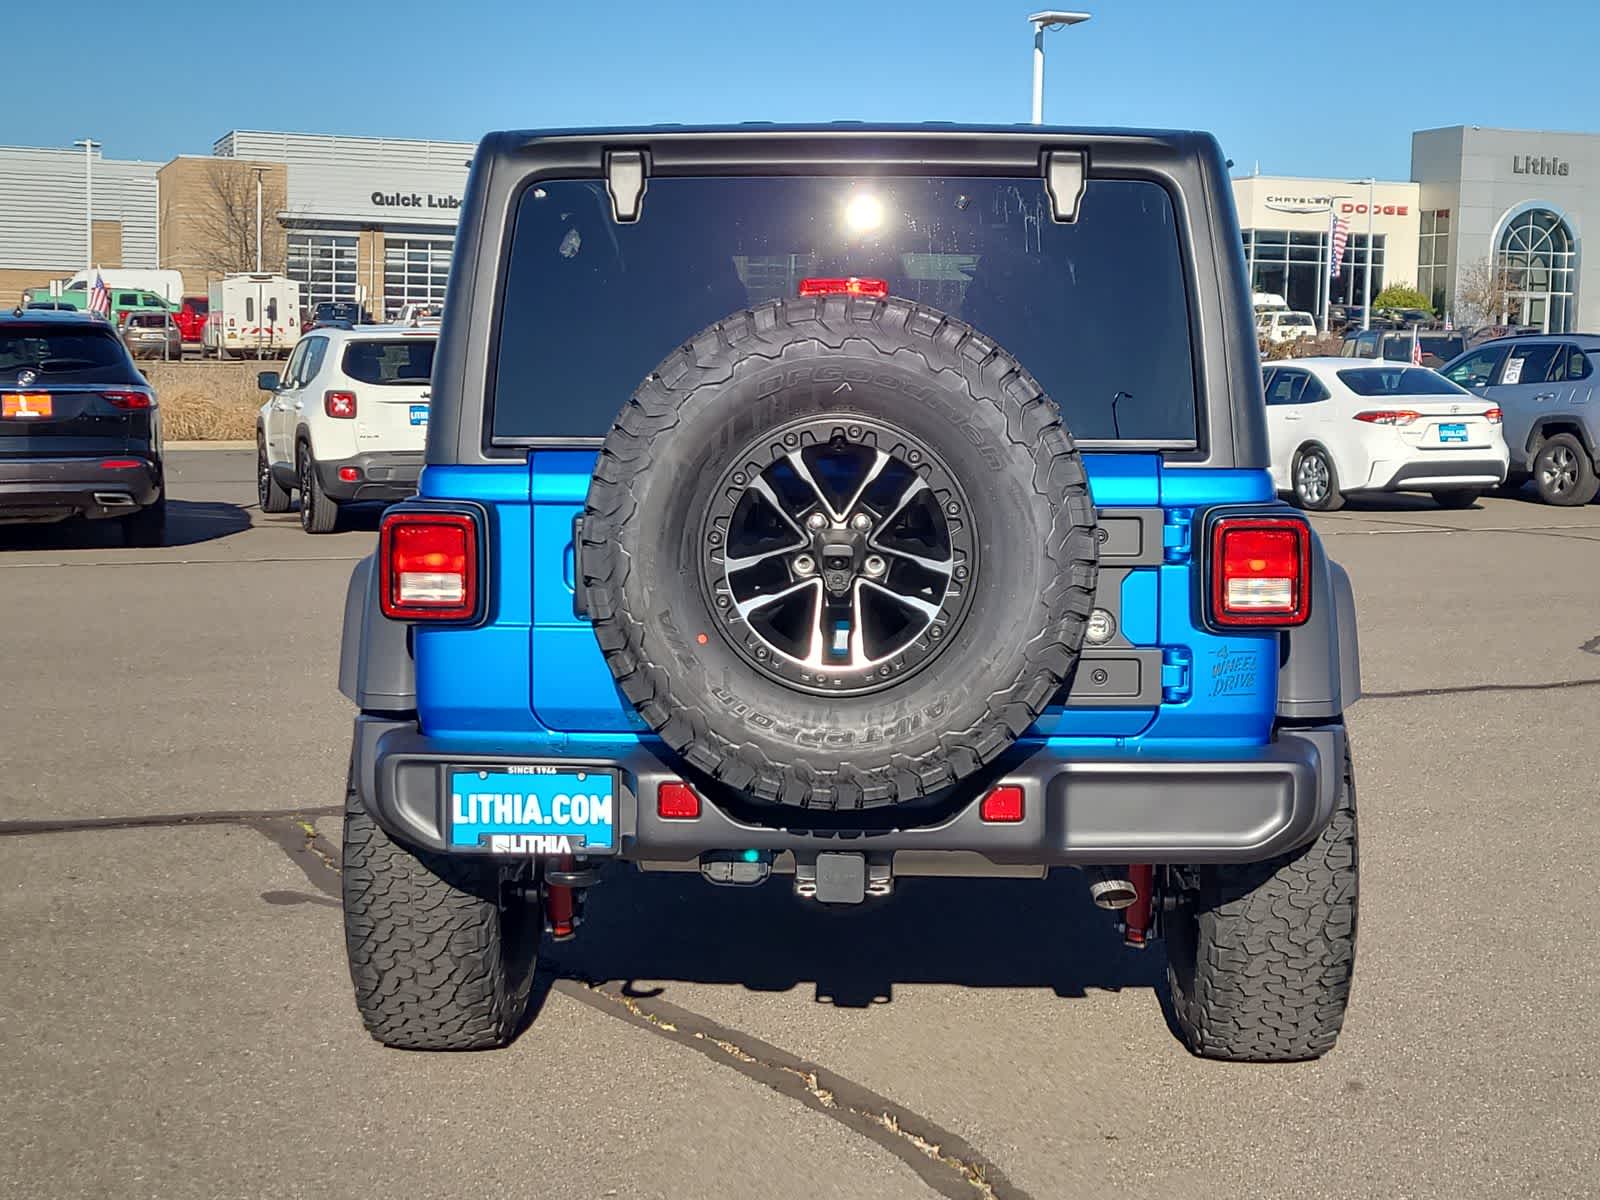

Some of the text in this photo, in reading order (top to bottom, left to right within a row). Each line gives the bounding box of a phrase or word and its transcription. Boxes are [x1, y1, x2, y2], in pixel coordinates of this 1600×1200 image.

[1512, 154, 1569, 177] Lithia
[371, 191, 422, 208] Quick
[1266, 195, 1330, 206] CHRYSLER
[1341, 203, 1409, 216] DODGE
[1211, 655, 1257, 678] WHEEL
[1212, 672, 1257, 696] DRIVE
[507, 766, 534, 775] SINCE
[452, 793, 613, 825] LITHIA.COM
[510, 834, 572, 854] LITHIA
